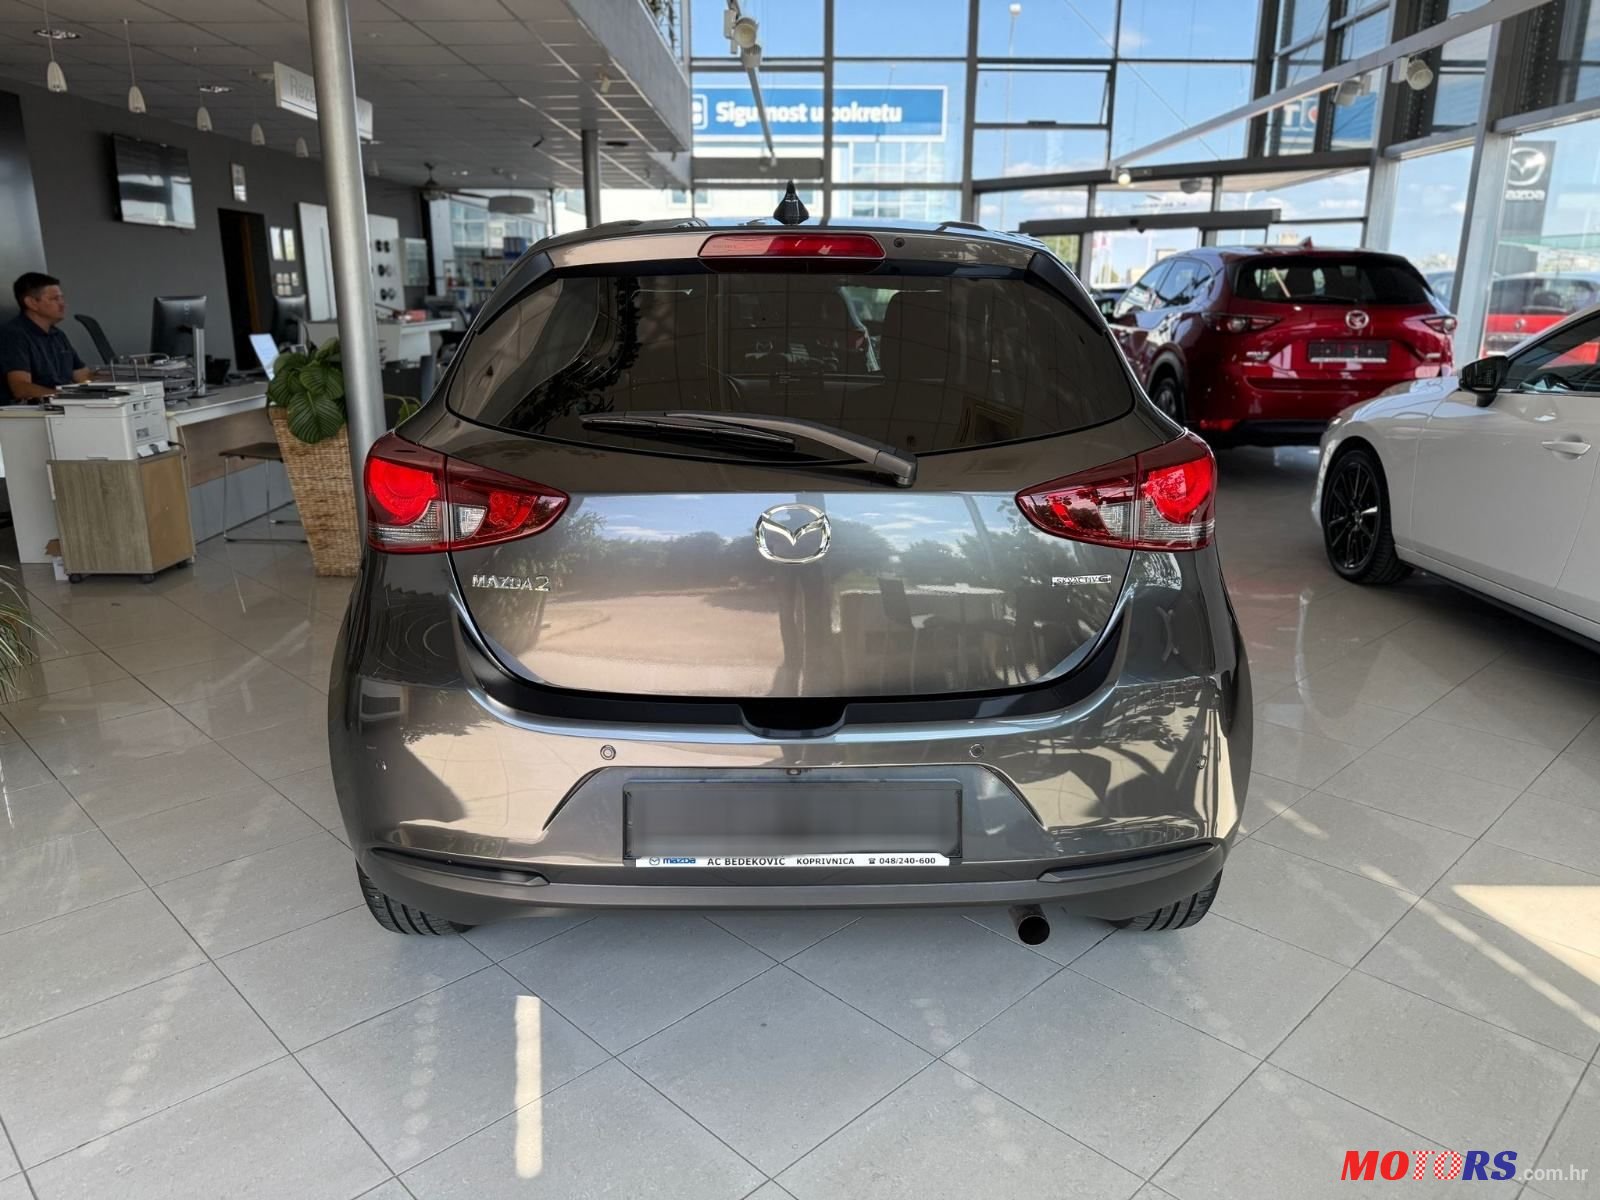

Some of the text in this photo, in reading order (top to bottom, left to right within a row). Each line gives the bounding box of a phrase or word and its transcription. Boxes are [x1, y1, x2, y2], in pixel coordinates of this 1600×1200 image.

[715, 101, 807, 127] Sigunost
[707, 857, 721, 866] AC
[796, 857, 855, 865] KOPRIVNICA
[879, 857, 936, 865] 048/240-600
